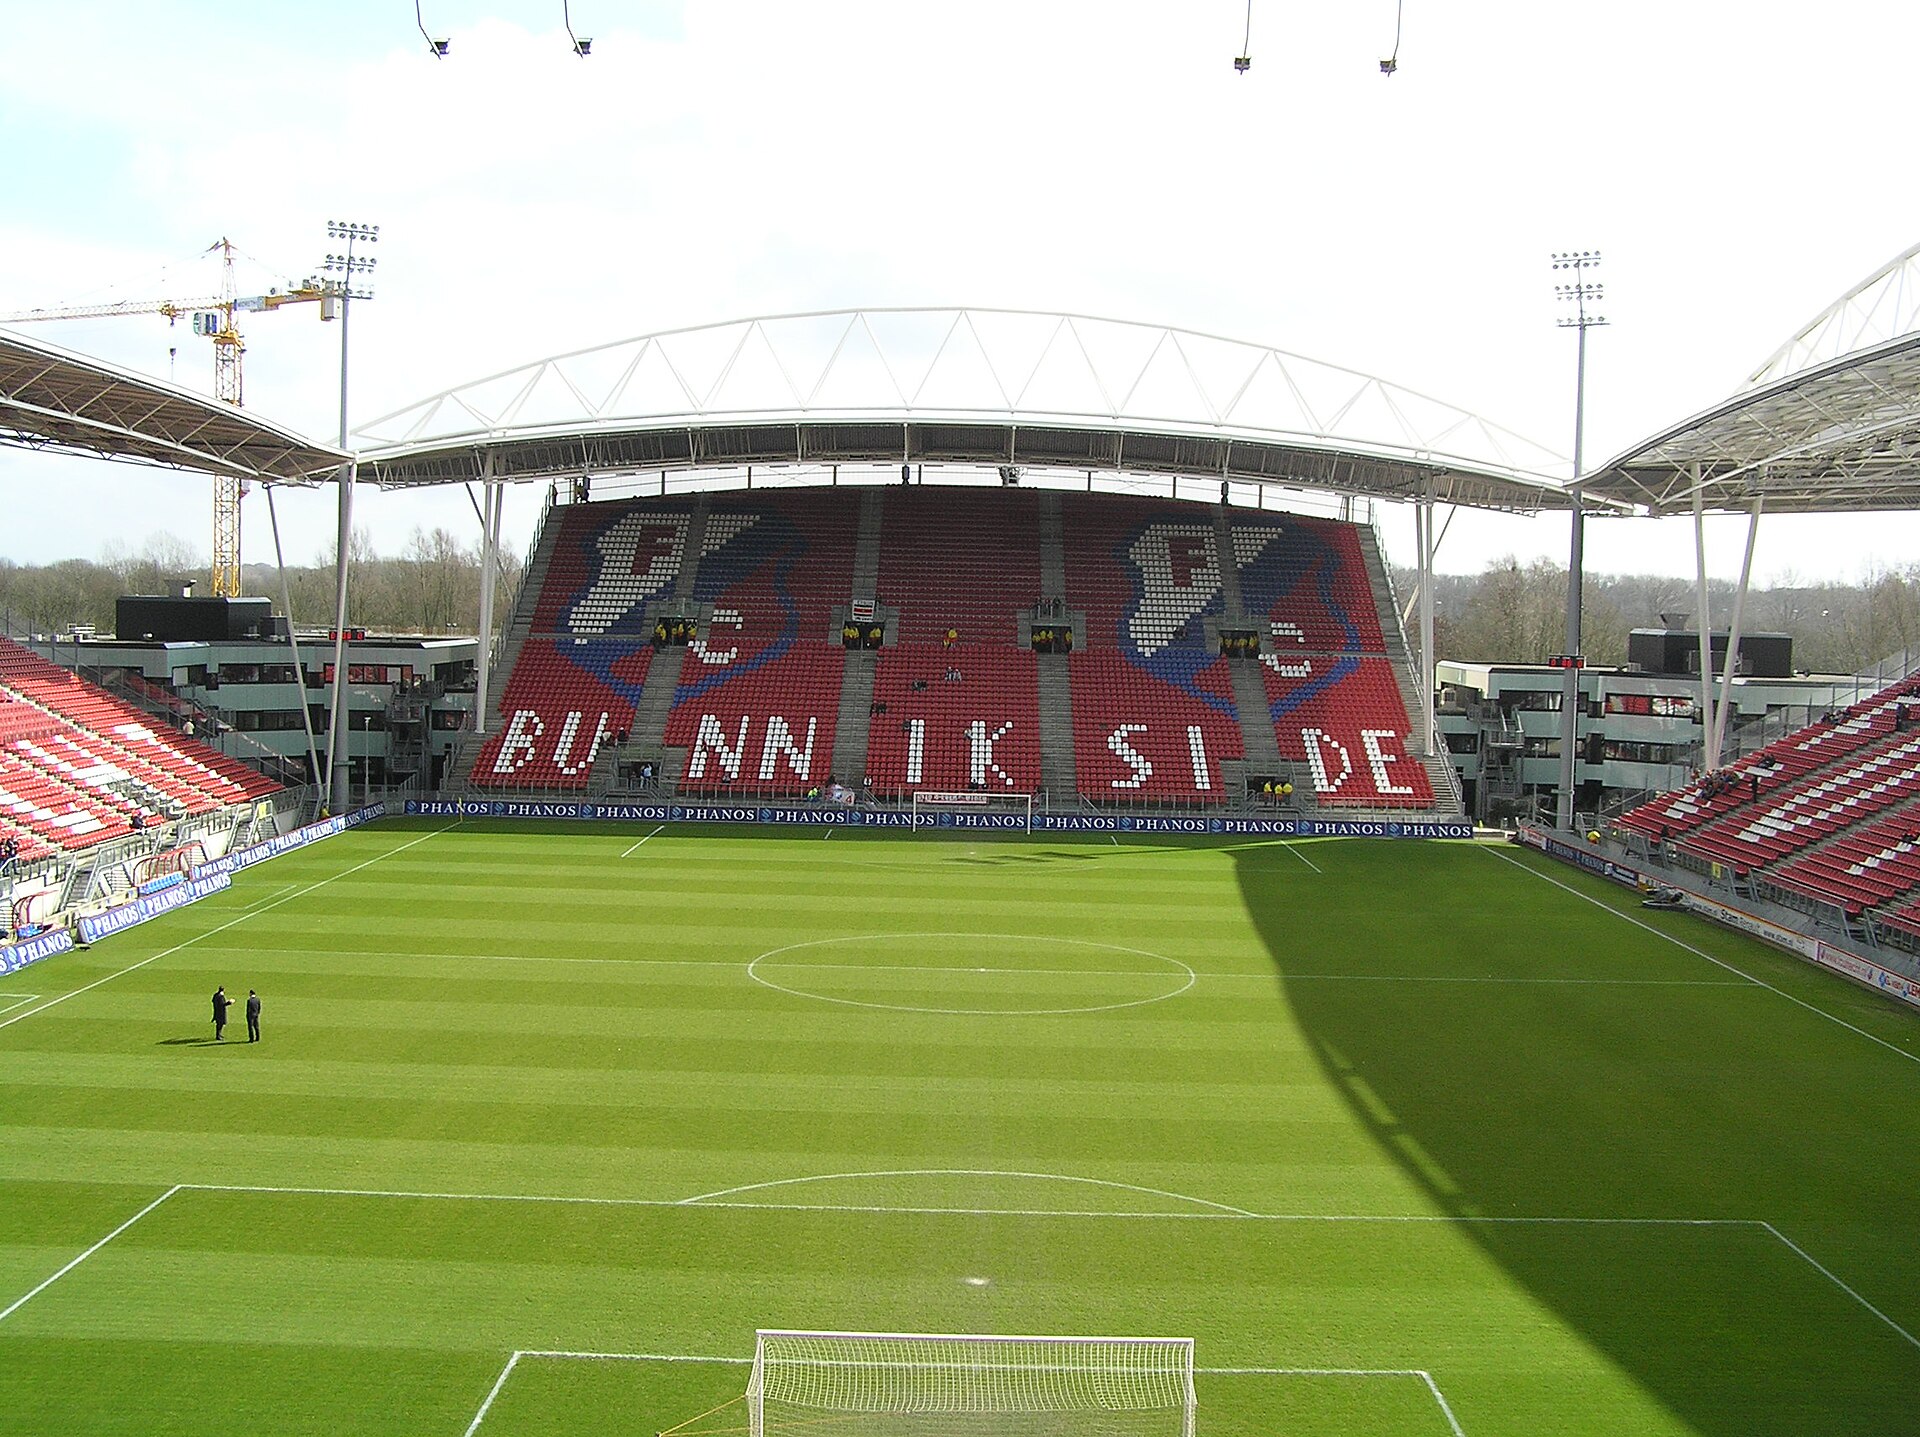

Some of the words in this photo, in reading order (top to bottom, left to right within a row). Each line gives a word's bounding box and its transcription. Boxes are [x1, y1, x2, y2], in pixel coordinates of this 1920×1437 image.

[420, 802, 488, 814] PHANOS
[508, 804, 576, 816] PHANOS
[596, 806, 666, 818] PHANOS
[685, 808, 755, 820] PHANOS
[336, 812, 360, 831] PHANOS
[775, 810, 845, 823] PHANOS
[865, 813, 935, 825] PHANOS
[955, 815, 1025, 827] PHANOS
[1045, 817, 1115, 829] PHANOS
[307, 822, 333, 841] PHANOS
[1135, 819, 1205, 831] PHANOS
[1225, 820, 1294, 833] PHANOS
[1314, 822, 1384, 835] PHANOS
[1403, 824, 1472, 837] PHANOS
[275, 832, 303, 851] PHANOS
[240, 844, 271, 865] PHANOS
[200, 855, 235, 877] PHANOS
[195, 871, 232, 894] PHANOS
[146, 885, 188, 916] PHANOS
[93, 904, 139, 935] PHANOS
[17, 930, 73, 965] PHANOS
